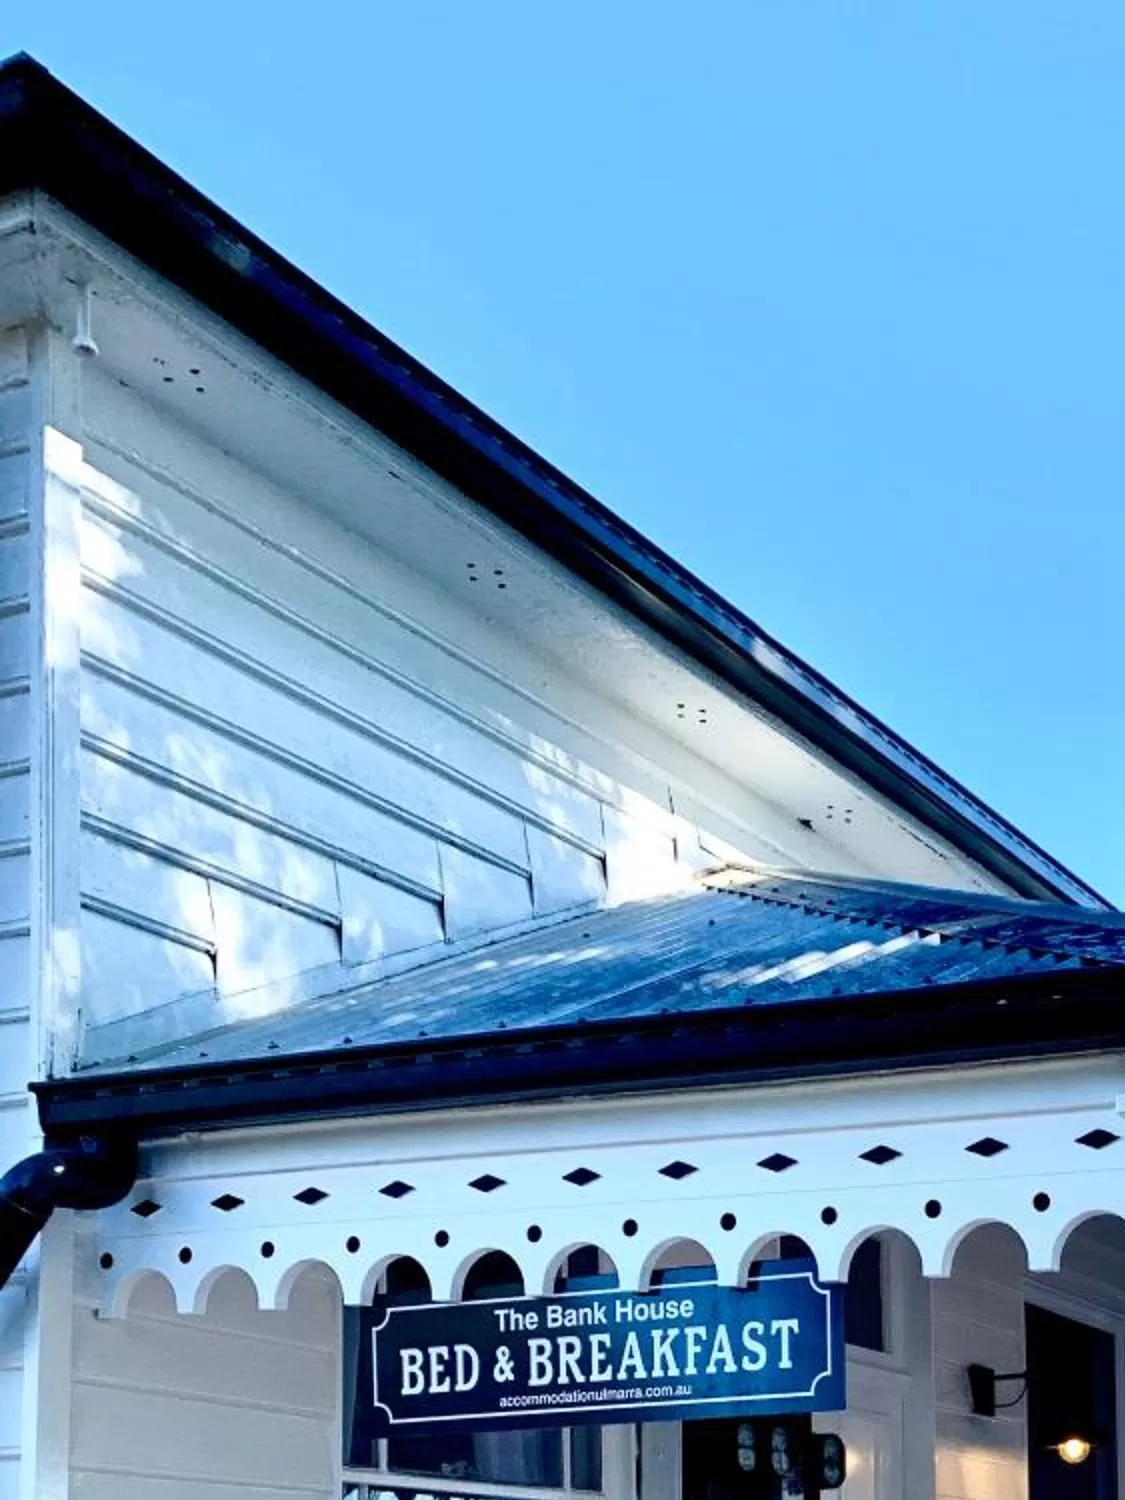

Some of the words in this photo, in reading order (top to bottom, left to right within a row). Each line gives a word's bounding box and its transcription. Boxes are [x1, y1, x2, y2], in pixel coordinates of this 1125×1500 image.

[494, 1308, 538, 1333] The
[547, 1302, 607, 1328] Bank
[616, 1298, 694, 1324] House
[400, 1342, 480, 1396] BED
[493, 1345, 515, 1384] &
[527, 1318, 800, 1388] BREAKFAST
[499, 1384, 693, 1408] accommodationulmarra.com.au
